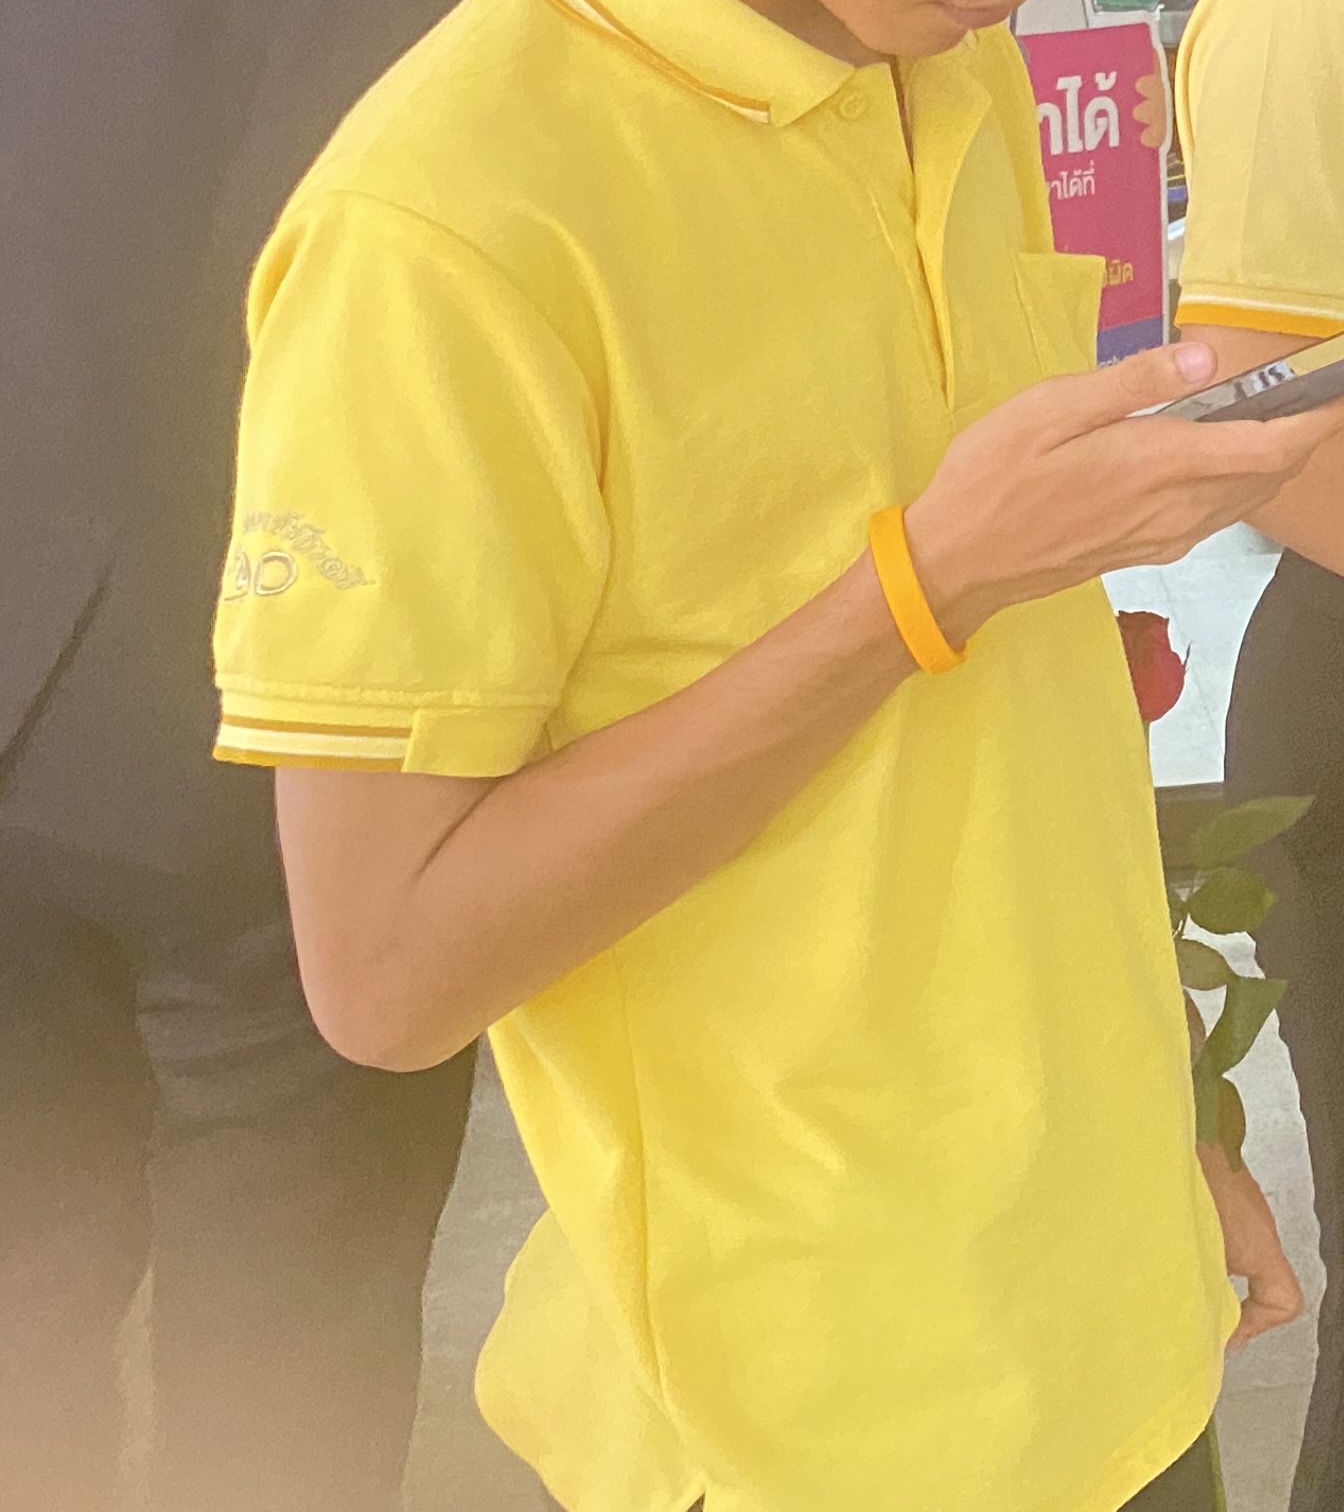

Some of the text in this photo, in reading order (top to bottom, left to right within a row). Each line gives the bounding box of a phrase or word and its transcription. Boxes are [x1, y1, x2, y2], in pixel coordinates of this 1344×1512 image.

[1036, 70, 1120, 156] าได้
[1046, 159, 1096, 200] าได้ที่
